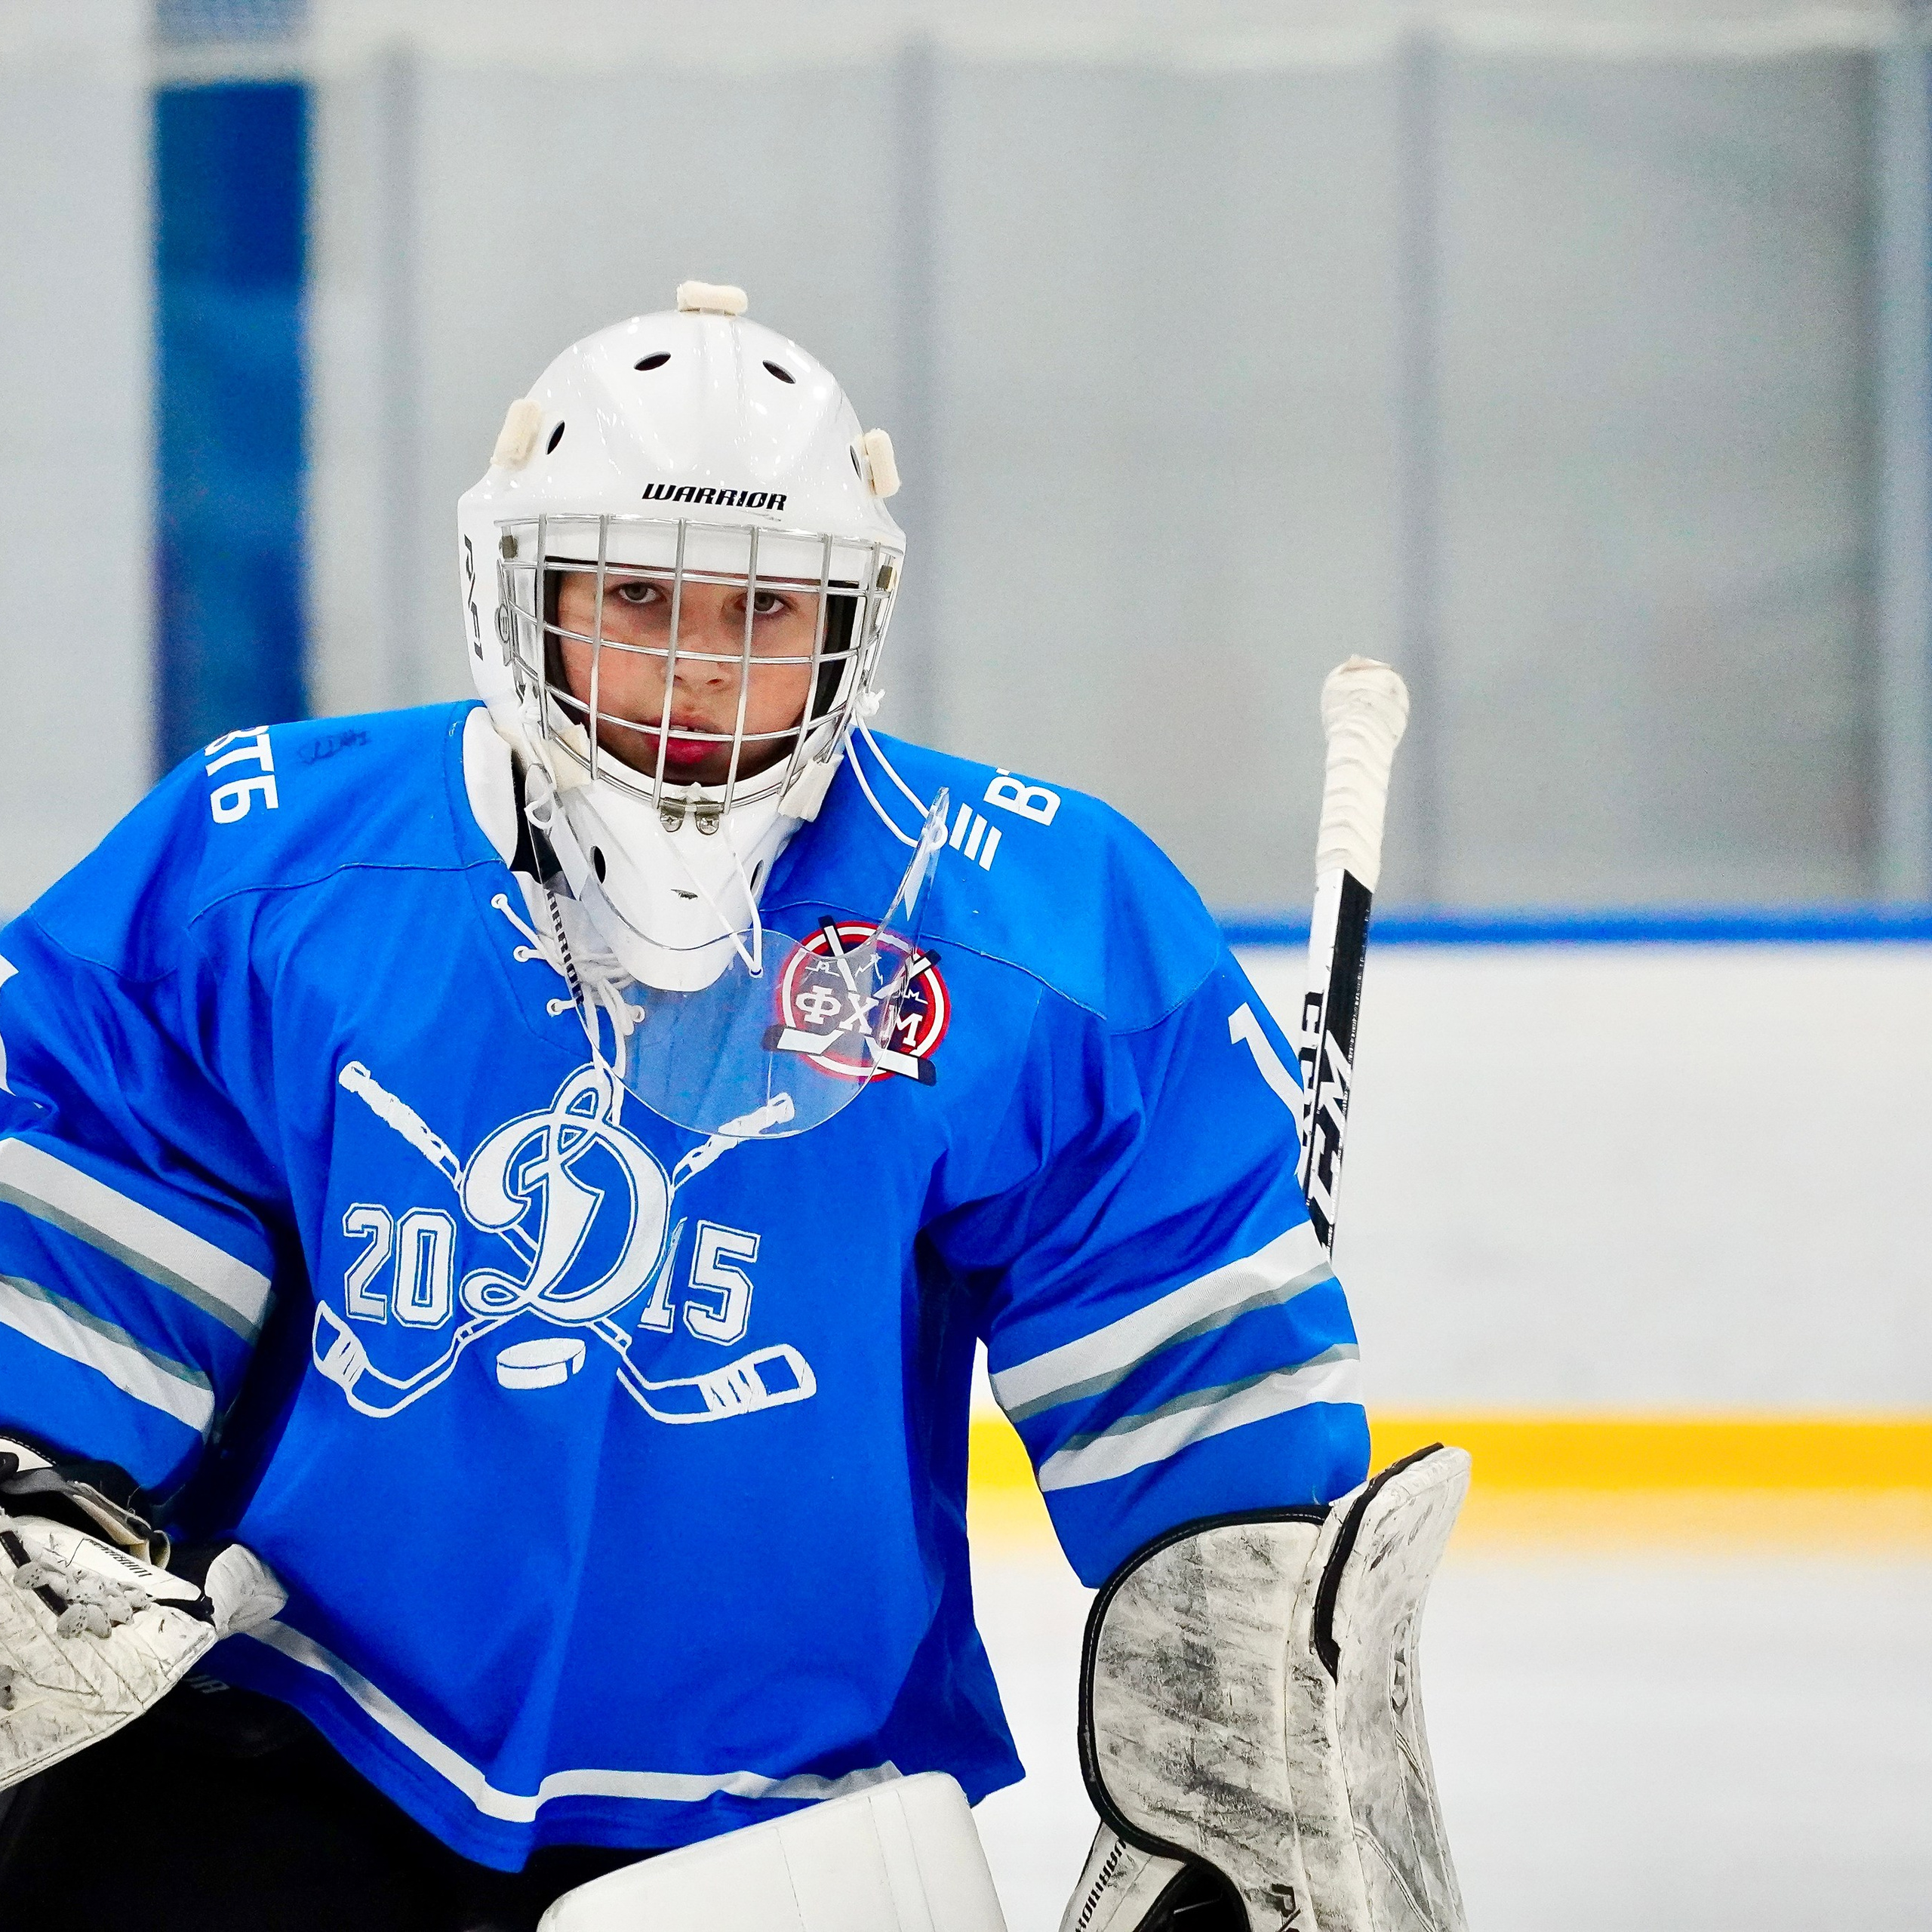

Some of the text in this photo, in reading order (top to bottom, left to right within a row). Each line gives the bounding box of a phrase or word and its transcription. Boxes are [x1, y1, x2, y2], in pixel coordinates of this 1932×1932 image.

[641, 483, 787, 511] WARRIOR
[546, 890, 585, 1005] ARRIOR
[342, 1202, 457, 1330] 20
[638, 1217, 761, 1346] 15
